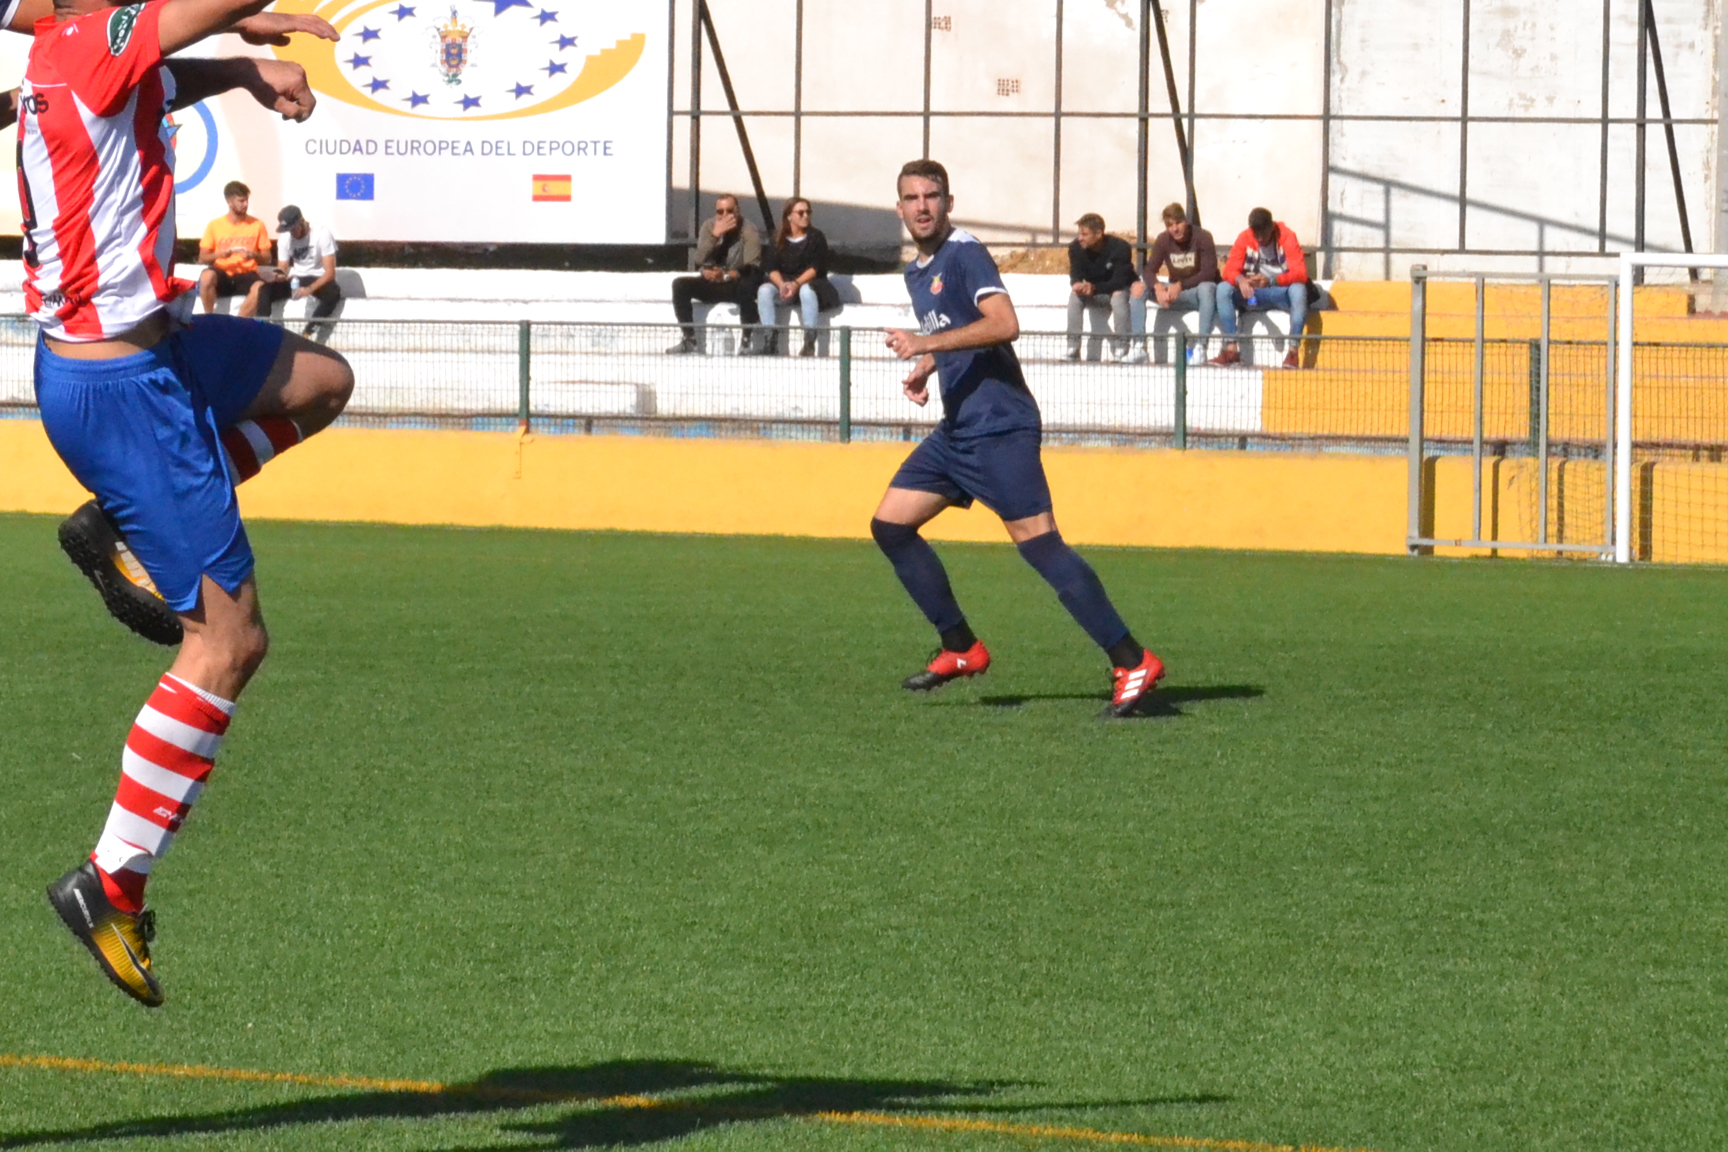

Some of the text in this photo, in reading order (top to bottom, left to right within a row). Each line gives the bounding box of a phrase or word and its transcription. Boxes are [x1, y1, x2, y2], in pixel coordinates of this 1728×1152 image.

[305, 138, 614, 157] CIUDAD EUROPEA DEL DEPORTE
